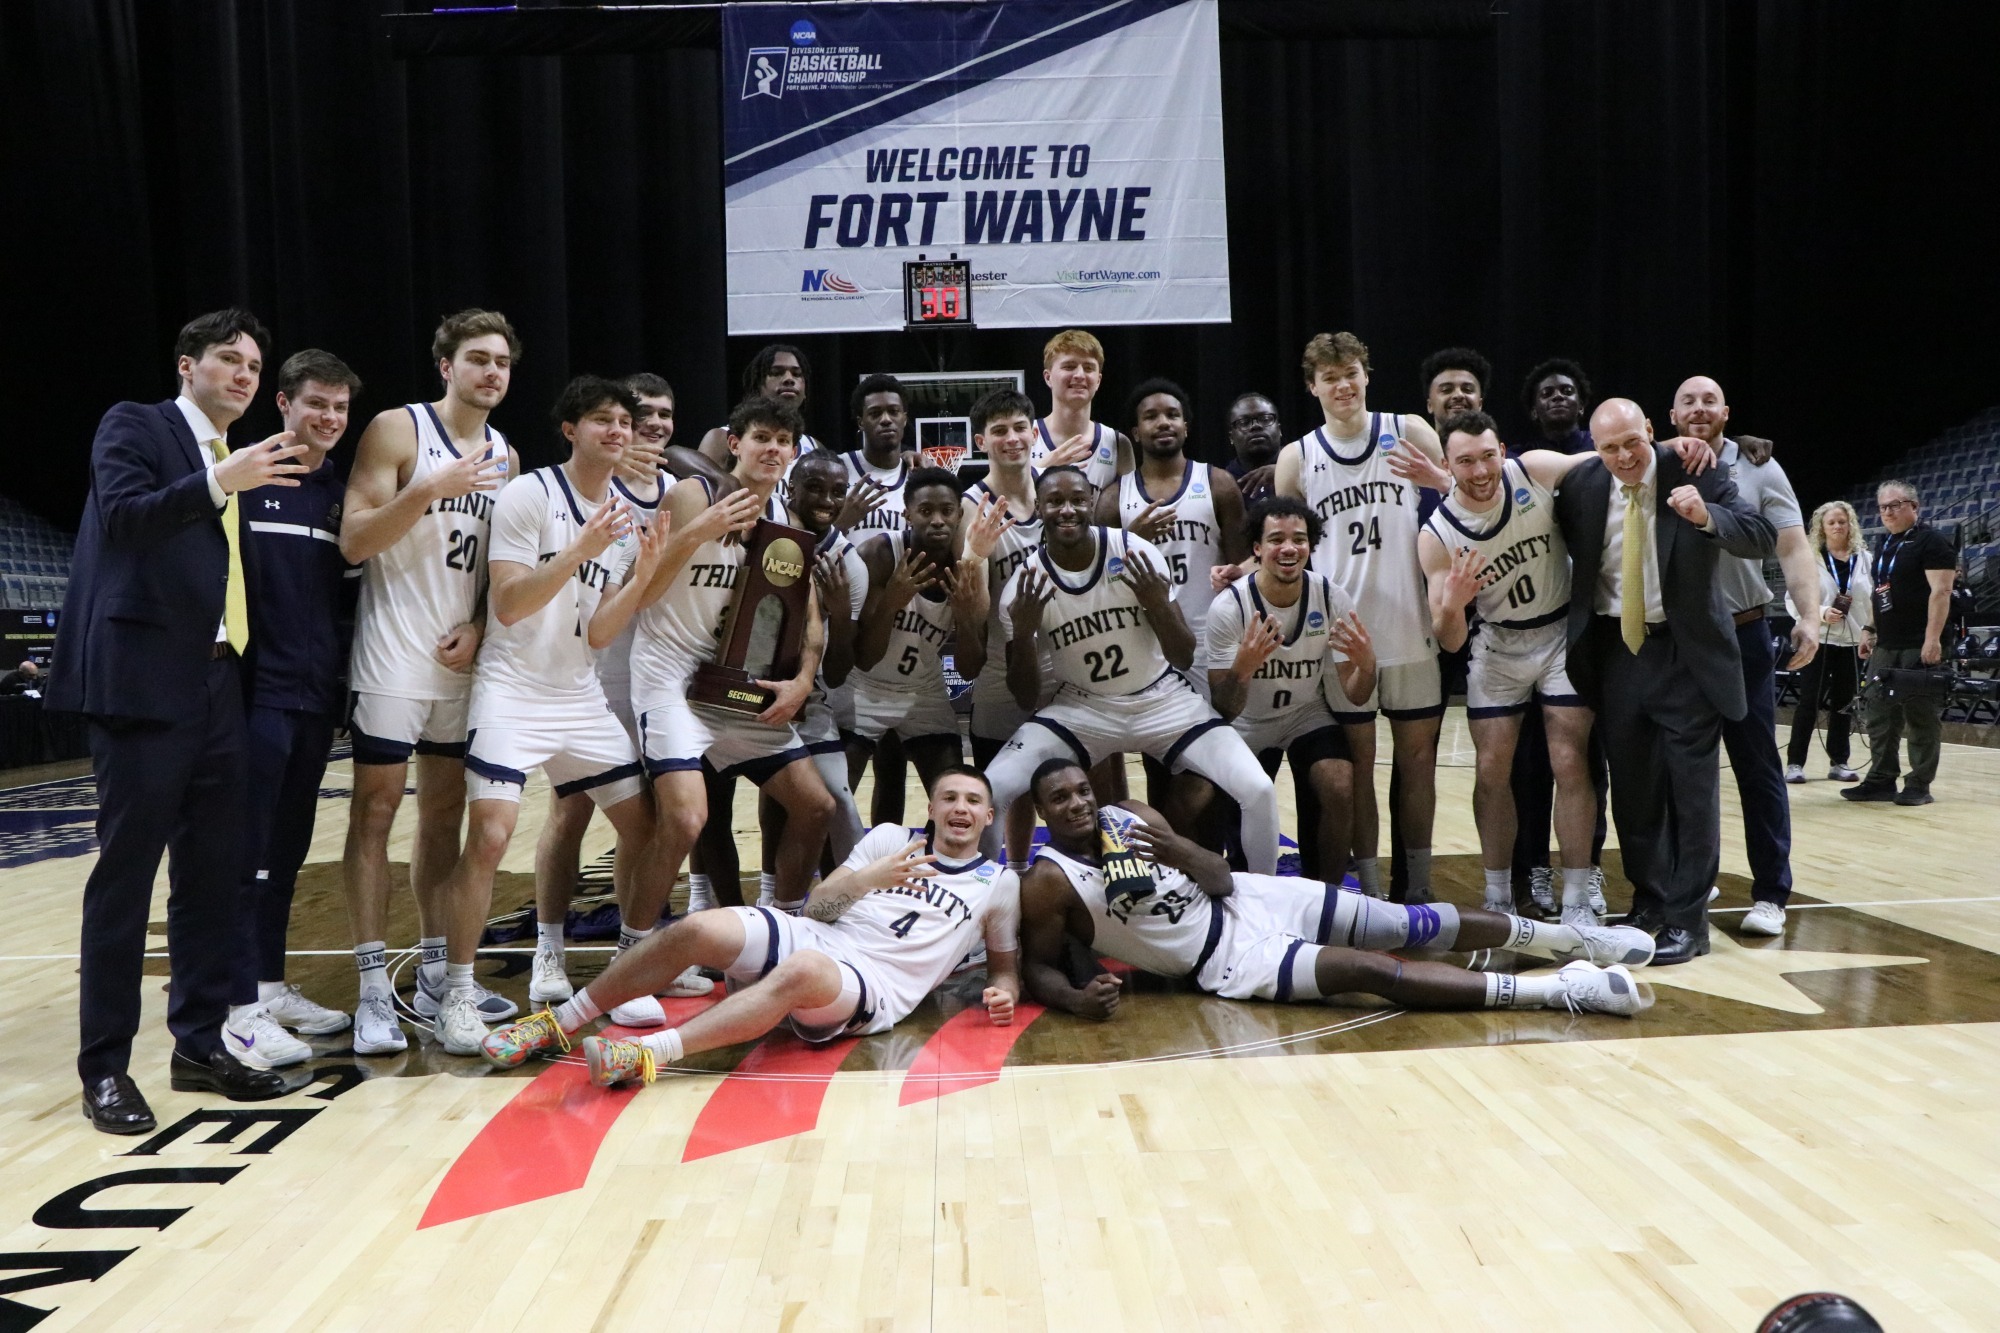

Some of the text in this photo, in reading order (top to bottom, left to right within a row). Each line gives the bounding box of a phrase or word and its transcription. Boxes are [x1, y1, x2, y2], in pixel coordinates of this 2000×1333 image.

[792, 31, 816, 39] NCAA
[787, 71, 866, 84] CHAMPIONSHIP
[789, 54, 883, 71] BASKETBALL
[866, 144, 1091, 183] WELCOME TO
[804, 187, 1152, 249] FORT WAYNE
[1057, 270, 1161, 282] VisitFortWayne.com
[922, 287, 960, 318] 30
[1316, 481, 1404, 521] TRINITY
[446, 529, 478, 573] 20
[1349, 515, 1382, 555] 24
[766, 557, 802, 579] NCAA
[1507, 574, 1536, 609] 10
[1049, 606, 1141, 651] TRINITY
[897, 645, 919, 676] 5
[1083, 644, 1129, 683] 22
[889, 910, 921, 939] 4
